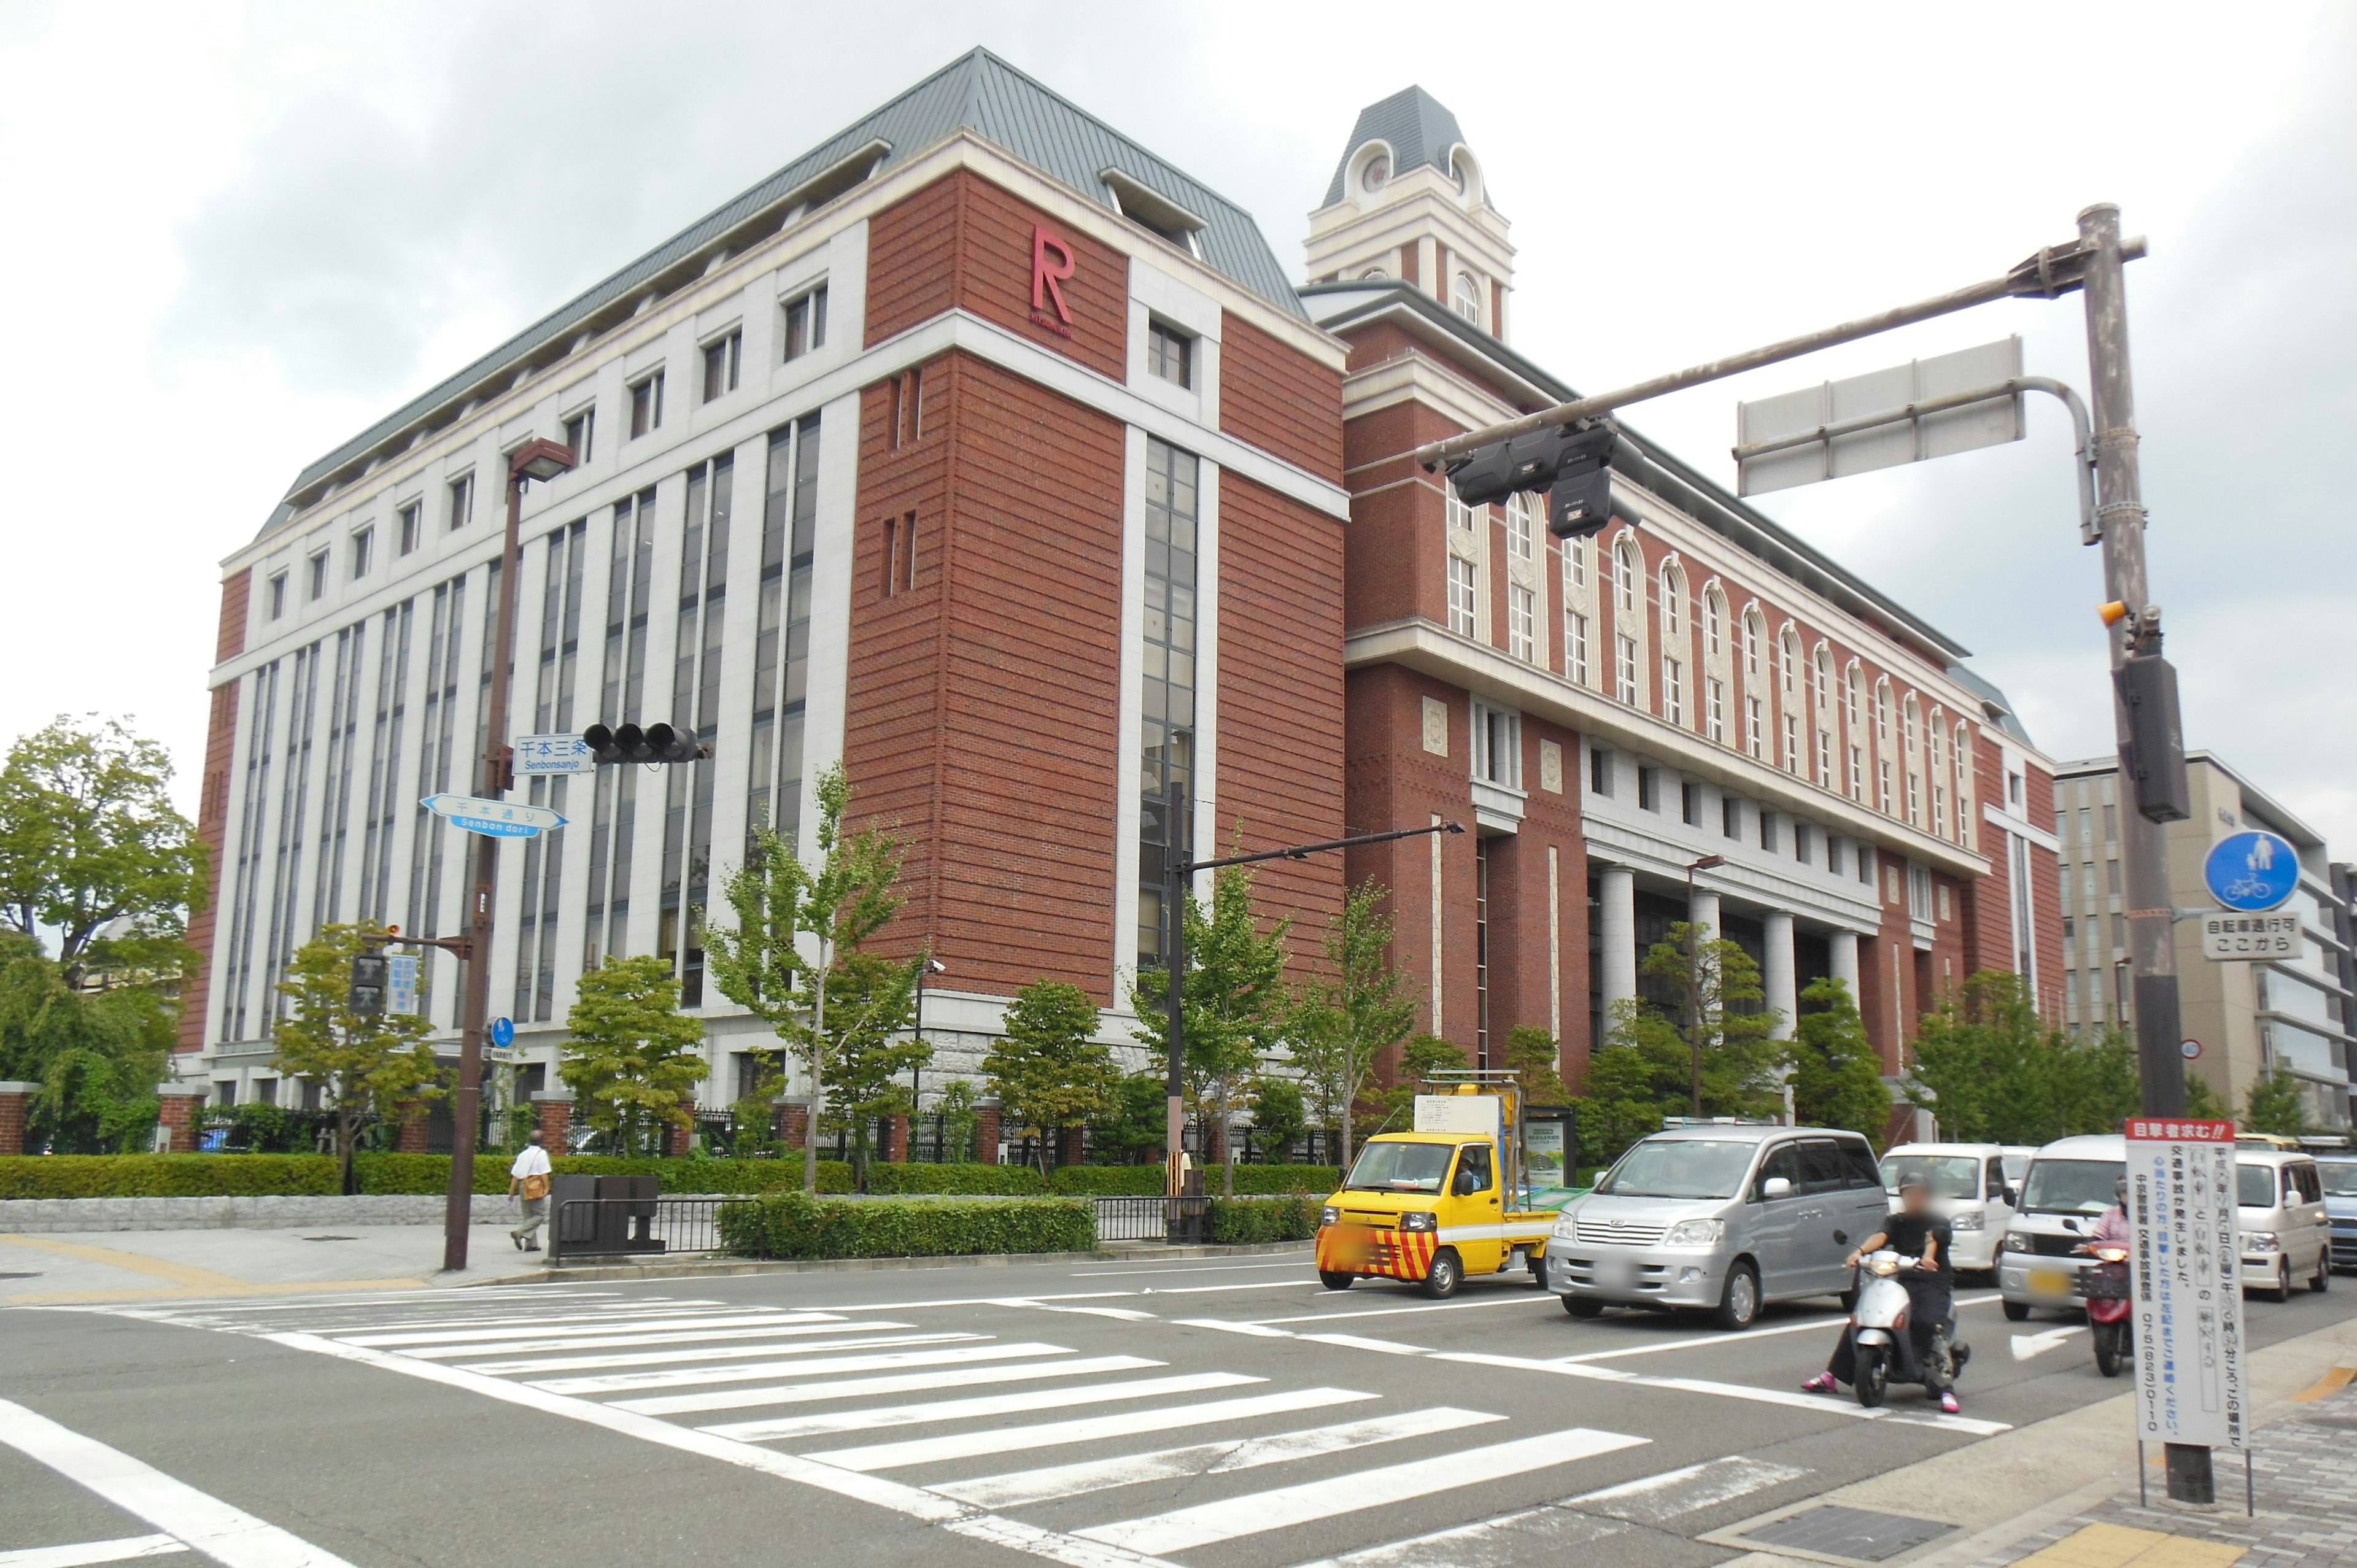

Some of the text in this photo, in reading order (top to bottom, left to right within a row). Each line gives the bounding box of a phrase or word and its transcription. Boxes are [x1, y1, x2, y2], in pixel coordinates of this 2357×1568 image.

[1033, 225, 1075, 325] R
[520, 739, 587, 758] 千本三条
[525, 759, 579, 770] Senbonsanjo
[456, 802, 535, 822] 千本通り
[461, 817, 528, 834] Senbon dori
[2208, 917, 2296, 934] 自転車通行可
[2216, 937, 2290, 952] ここから
